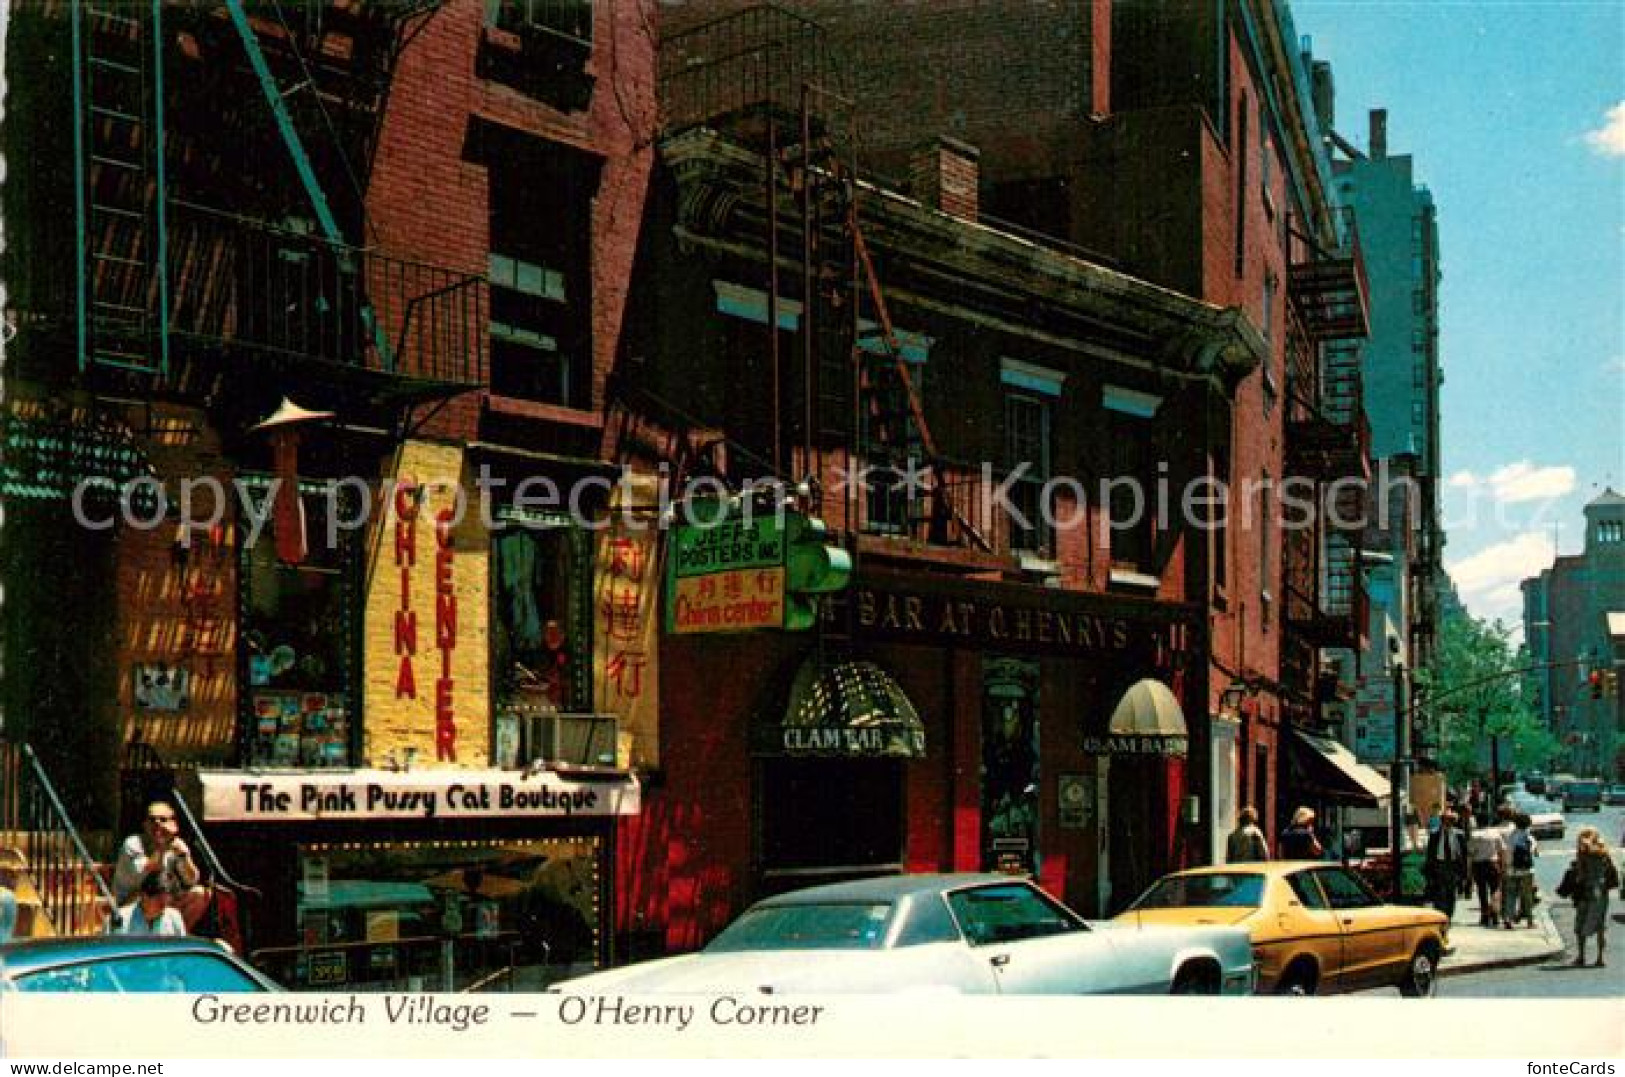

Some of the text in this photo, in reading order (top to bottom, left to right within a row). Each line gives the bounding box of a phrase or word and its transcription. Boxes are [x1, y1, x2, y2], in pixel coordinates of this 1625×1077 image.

[679, 542, 755, 568] POSTERS
[395, 480, 416, 700] CHINA
[859, 591, 923, 630] BAR
[940, 602, 975, 634] AT
[435, 508, 456, 762] CENTER
[784, 728, 839, 749] CLAM
[240, 784, 598, 817] The Pink Pussy Cat Boutique
